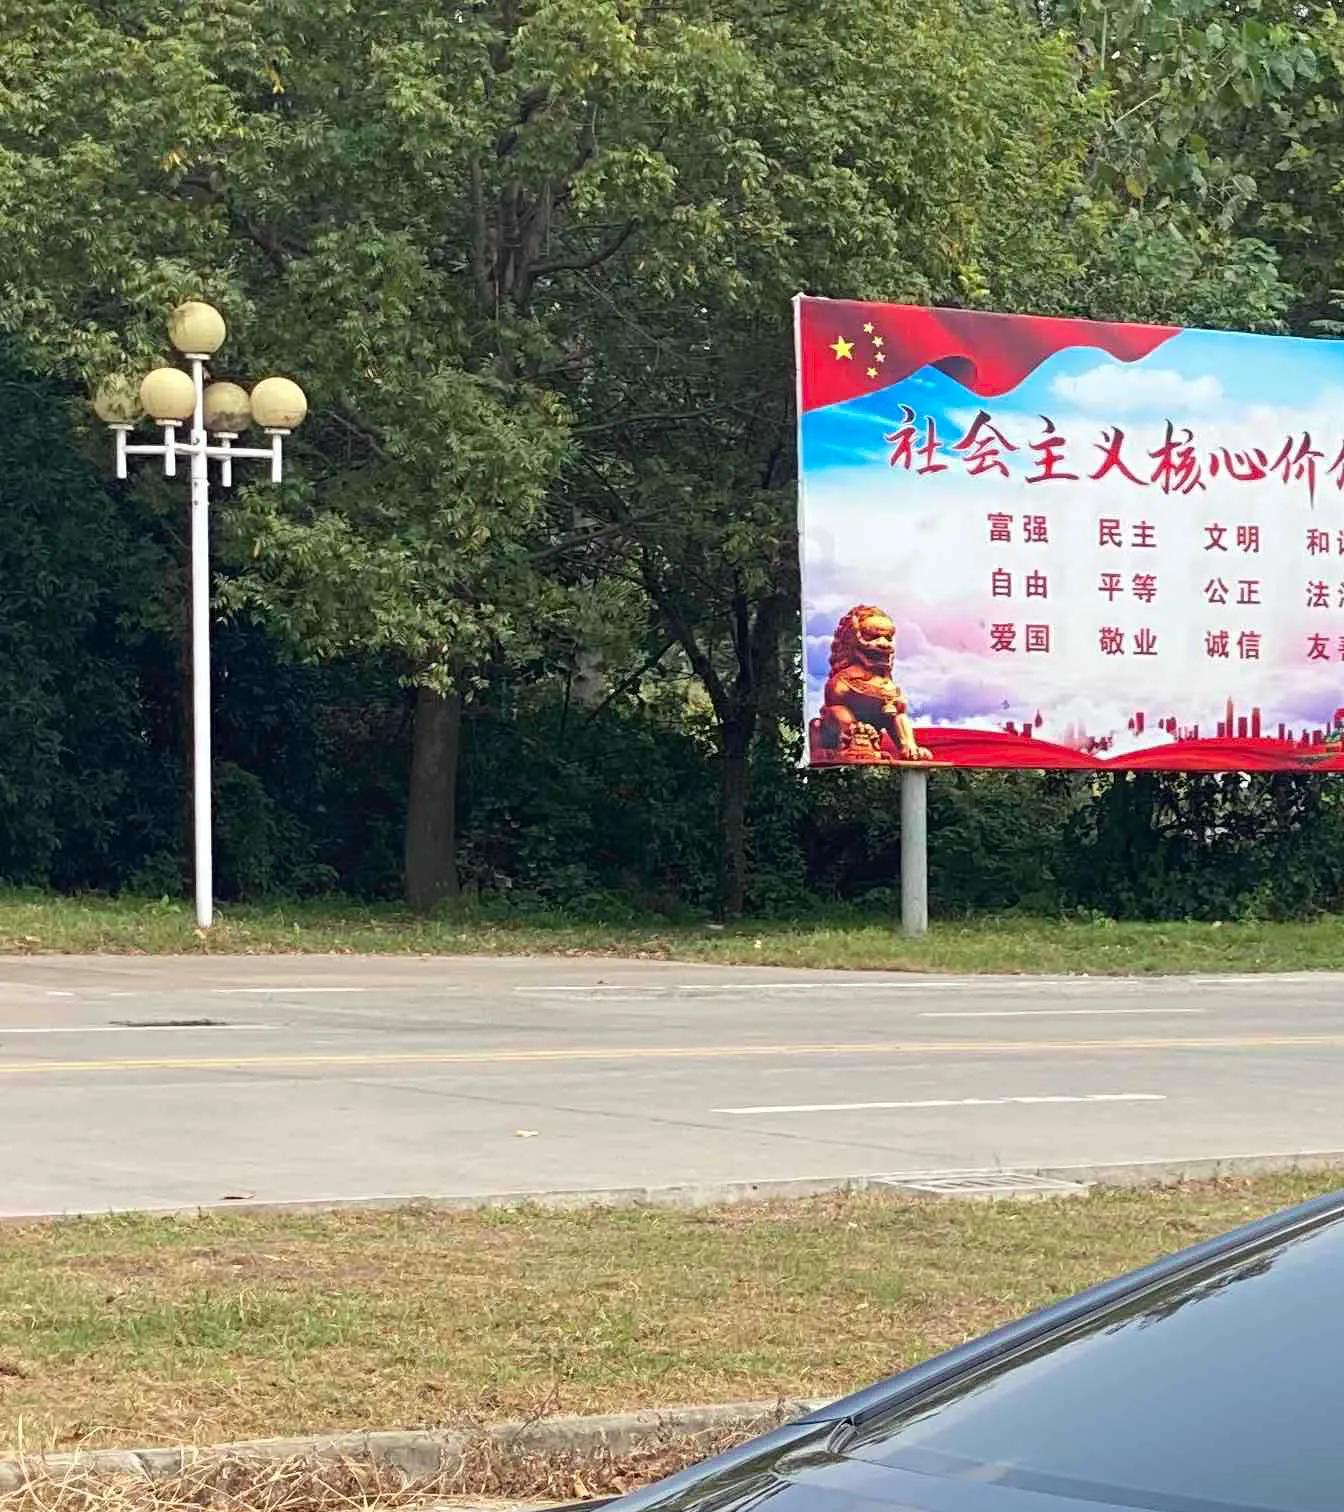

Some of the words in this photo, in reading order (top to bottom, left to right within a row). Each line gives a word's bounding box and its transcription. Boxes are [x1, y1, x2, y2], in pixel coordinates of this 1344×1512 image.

[987, 512, 1049, 544] 富强
[1098, 518, 1157, 549] 民主
[1204, 523, 1261, 553] 文明
[990, 567, 1049, 599] 自由
[1098, 572, 1157, 603] 平等
[1204, 577, 1262, 606] 公正
[989, 622, 1050, 653] 爱国
[1099, 626, 1158, 657] 敬业
[1205, 630, 1262, 660] 诚信
